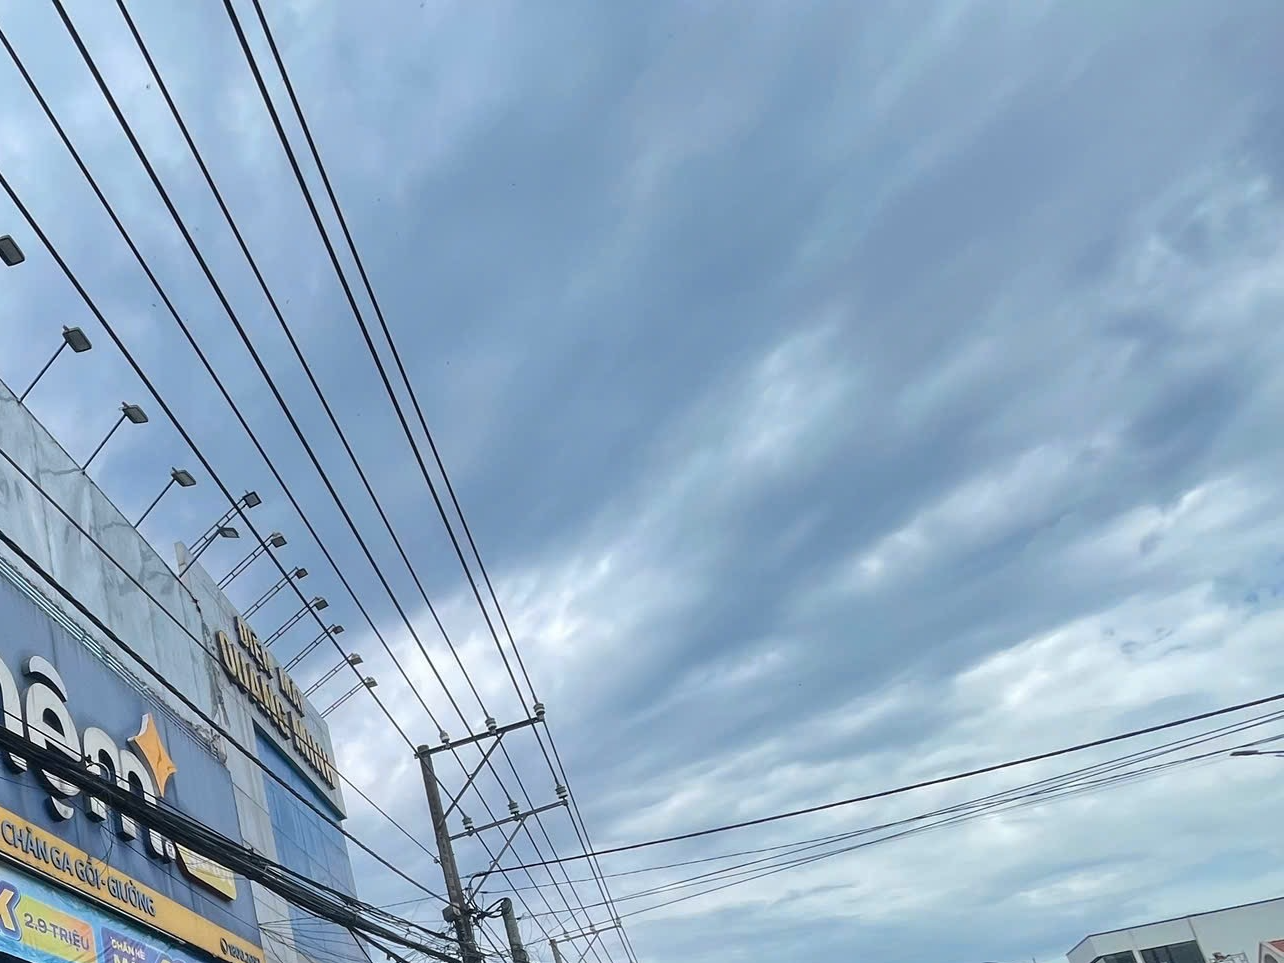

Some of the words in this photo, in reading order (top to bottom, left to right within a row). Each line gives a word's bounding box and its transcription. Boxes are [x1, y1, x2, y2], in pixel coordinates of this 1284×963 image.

[50, 846, 73, 876] GA
[24, 912, 47, 933] 2.9
[49, 922, 90, 951] TRIỆU
